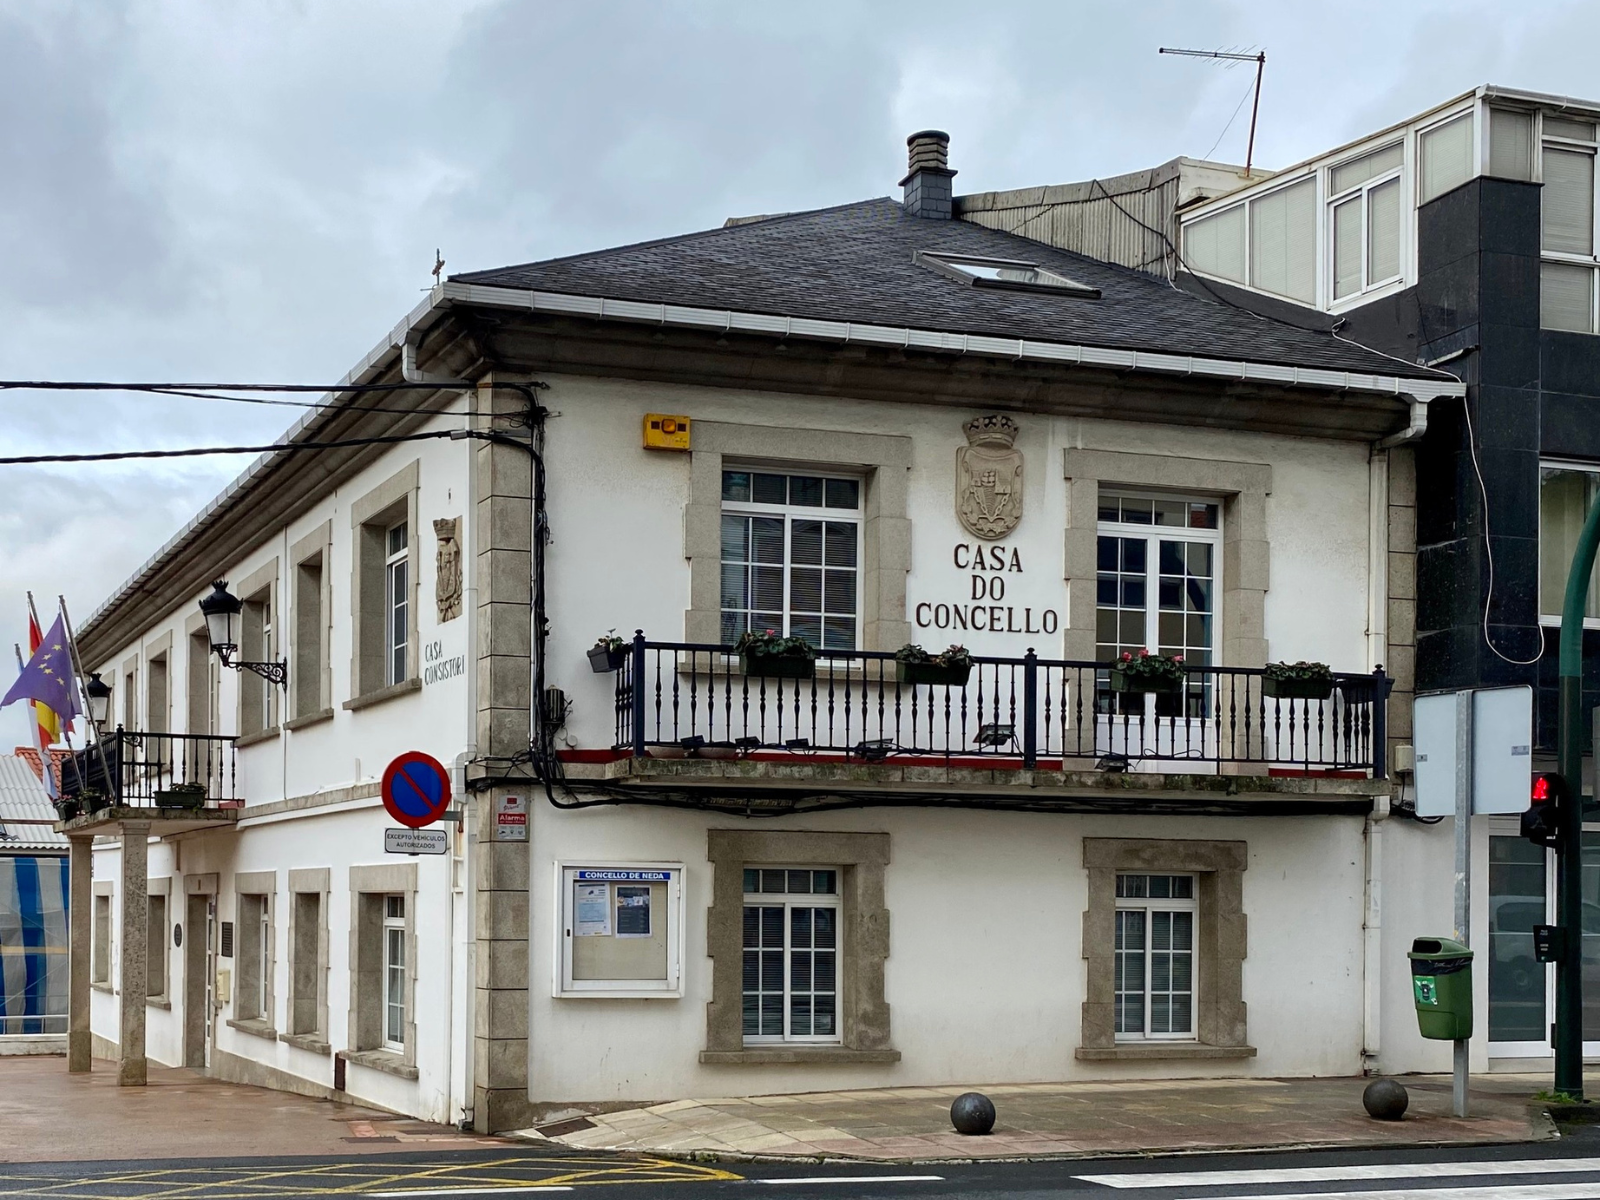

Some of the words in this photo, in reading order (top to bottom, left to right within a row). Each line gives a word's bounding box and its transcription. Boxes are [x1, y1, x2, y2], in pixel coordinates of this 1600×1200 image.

[953, 543, 1023, 573] CASA
[971, 574, 1005, 601] DO
[915, 602, 1058, 634] CONCELLO
[424, 639, 443, 662] CASA
[585, 871, 628, 879] CONCELLO
[642, 872, 664, 880] NEDA
